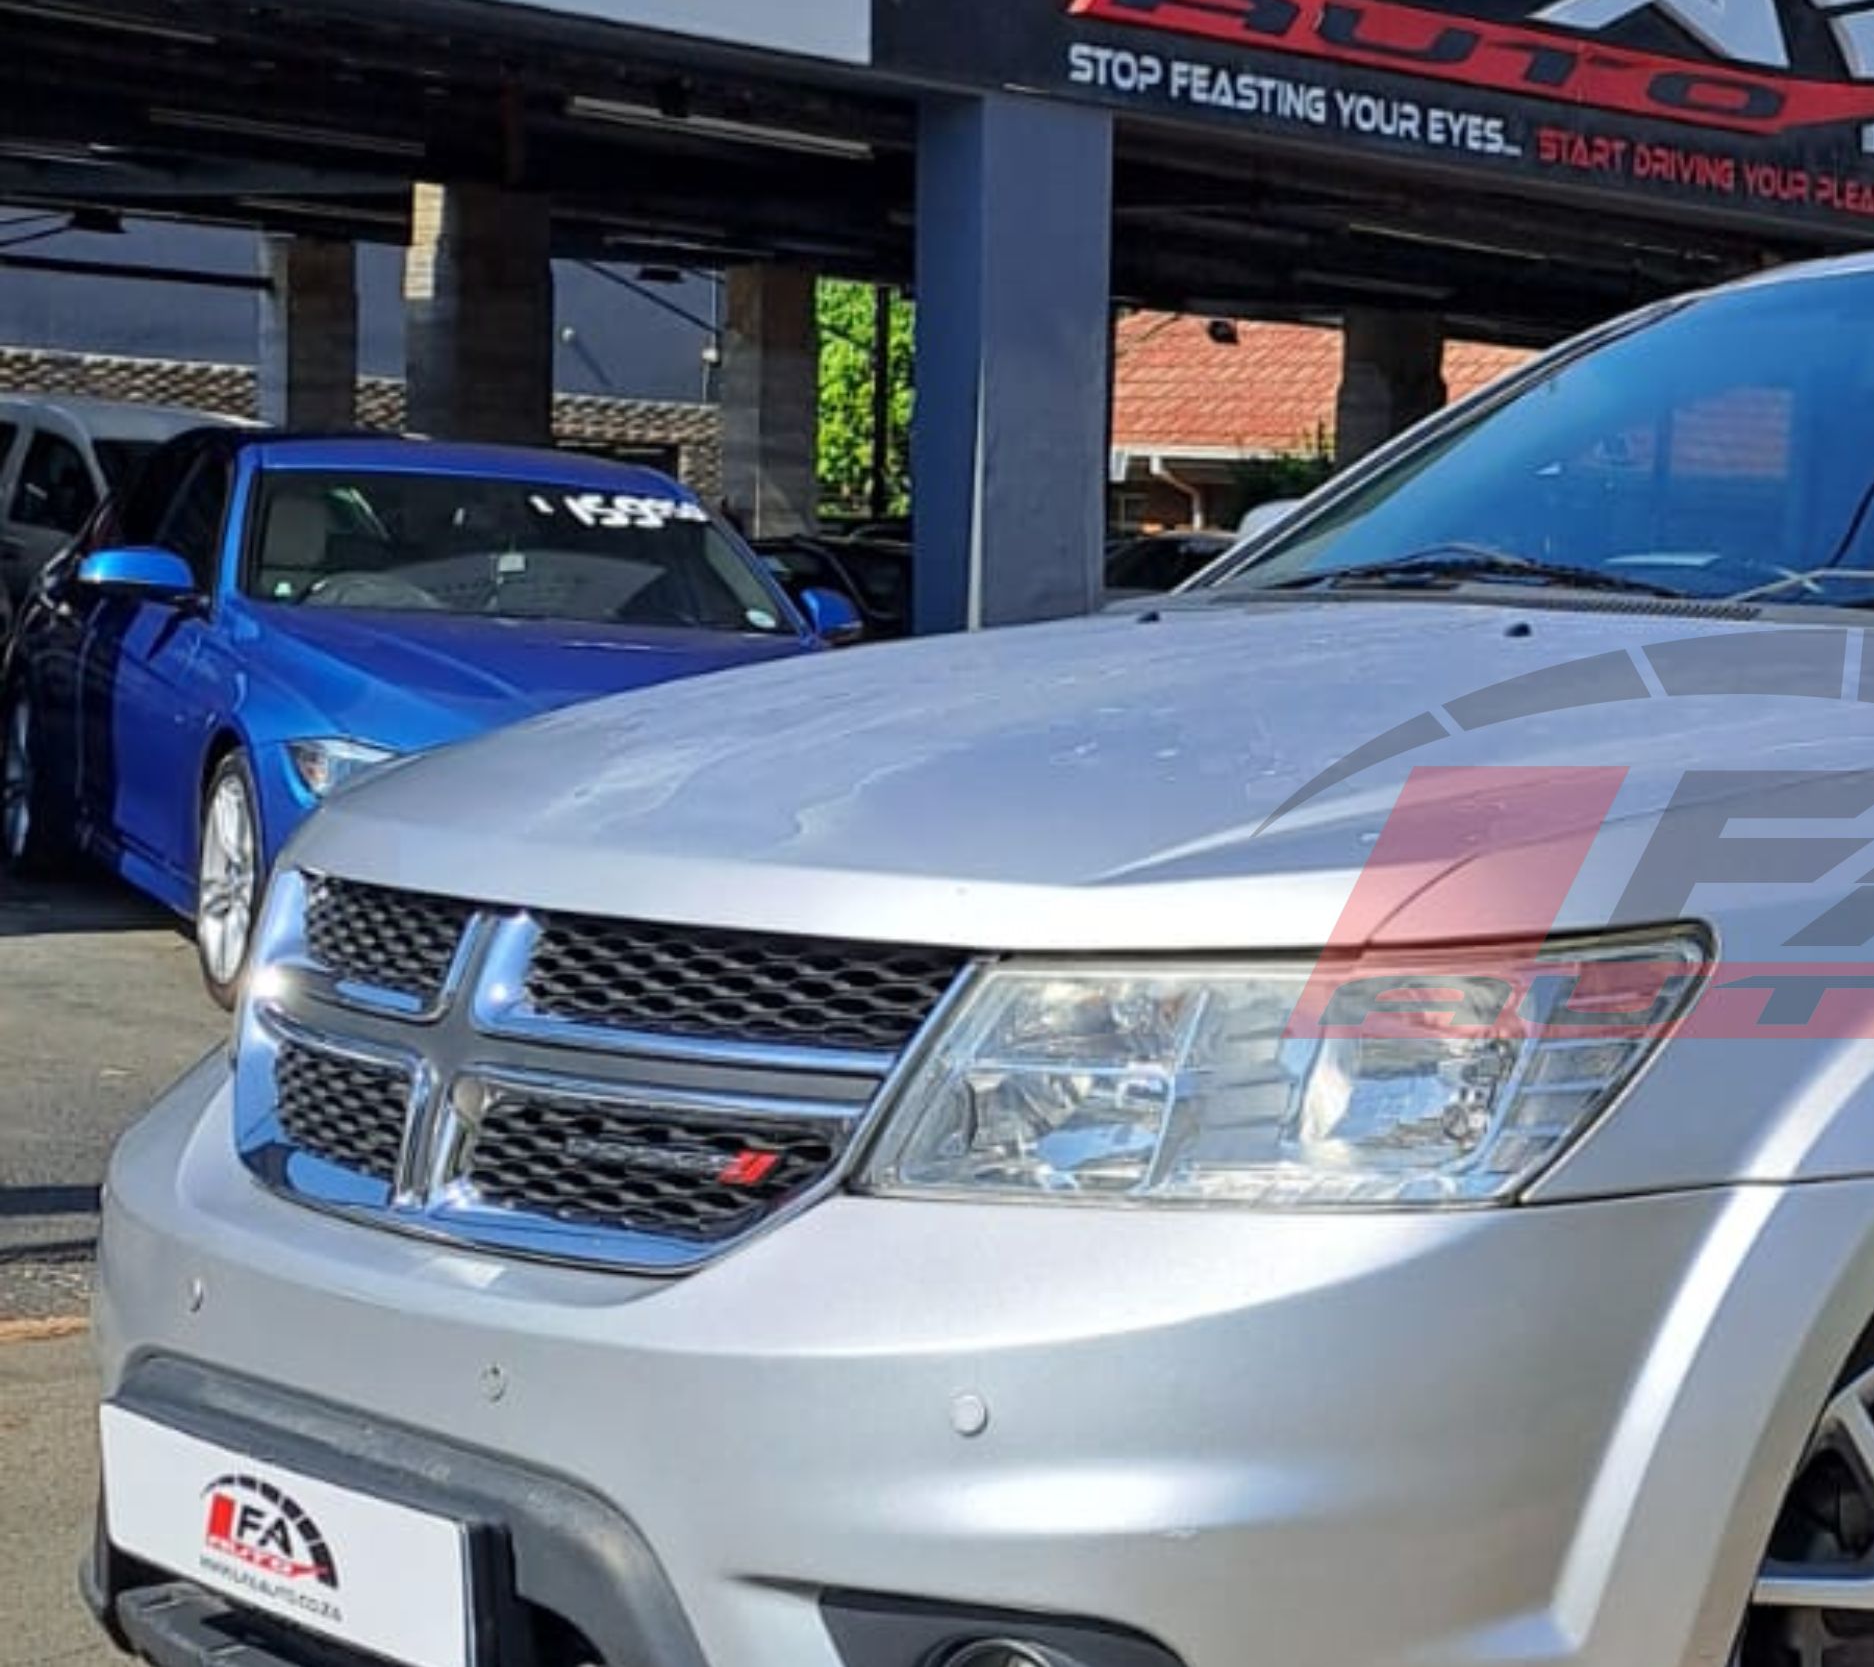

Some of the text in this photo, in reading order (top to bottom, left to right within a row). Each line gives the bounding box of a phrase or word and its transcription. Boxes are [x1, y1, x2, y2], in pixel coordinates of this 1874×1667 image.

[1068, 43, 1162, 90] STOP
[1170, 61, 1326, 123] FEASTING
[1334, 90, 1420, 139] YOUR
[1540, 128, 1627, 170] START
[1633, 150, 1735, 192] DRIVING
[1743, 163, 1811, 202] YOUR
